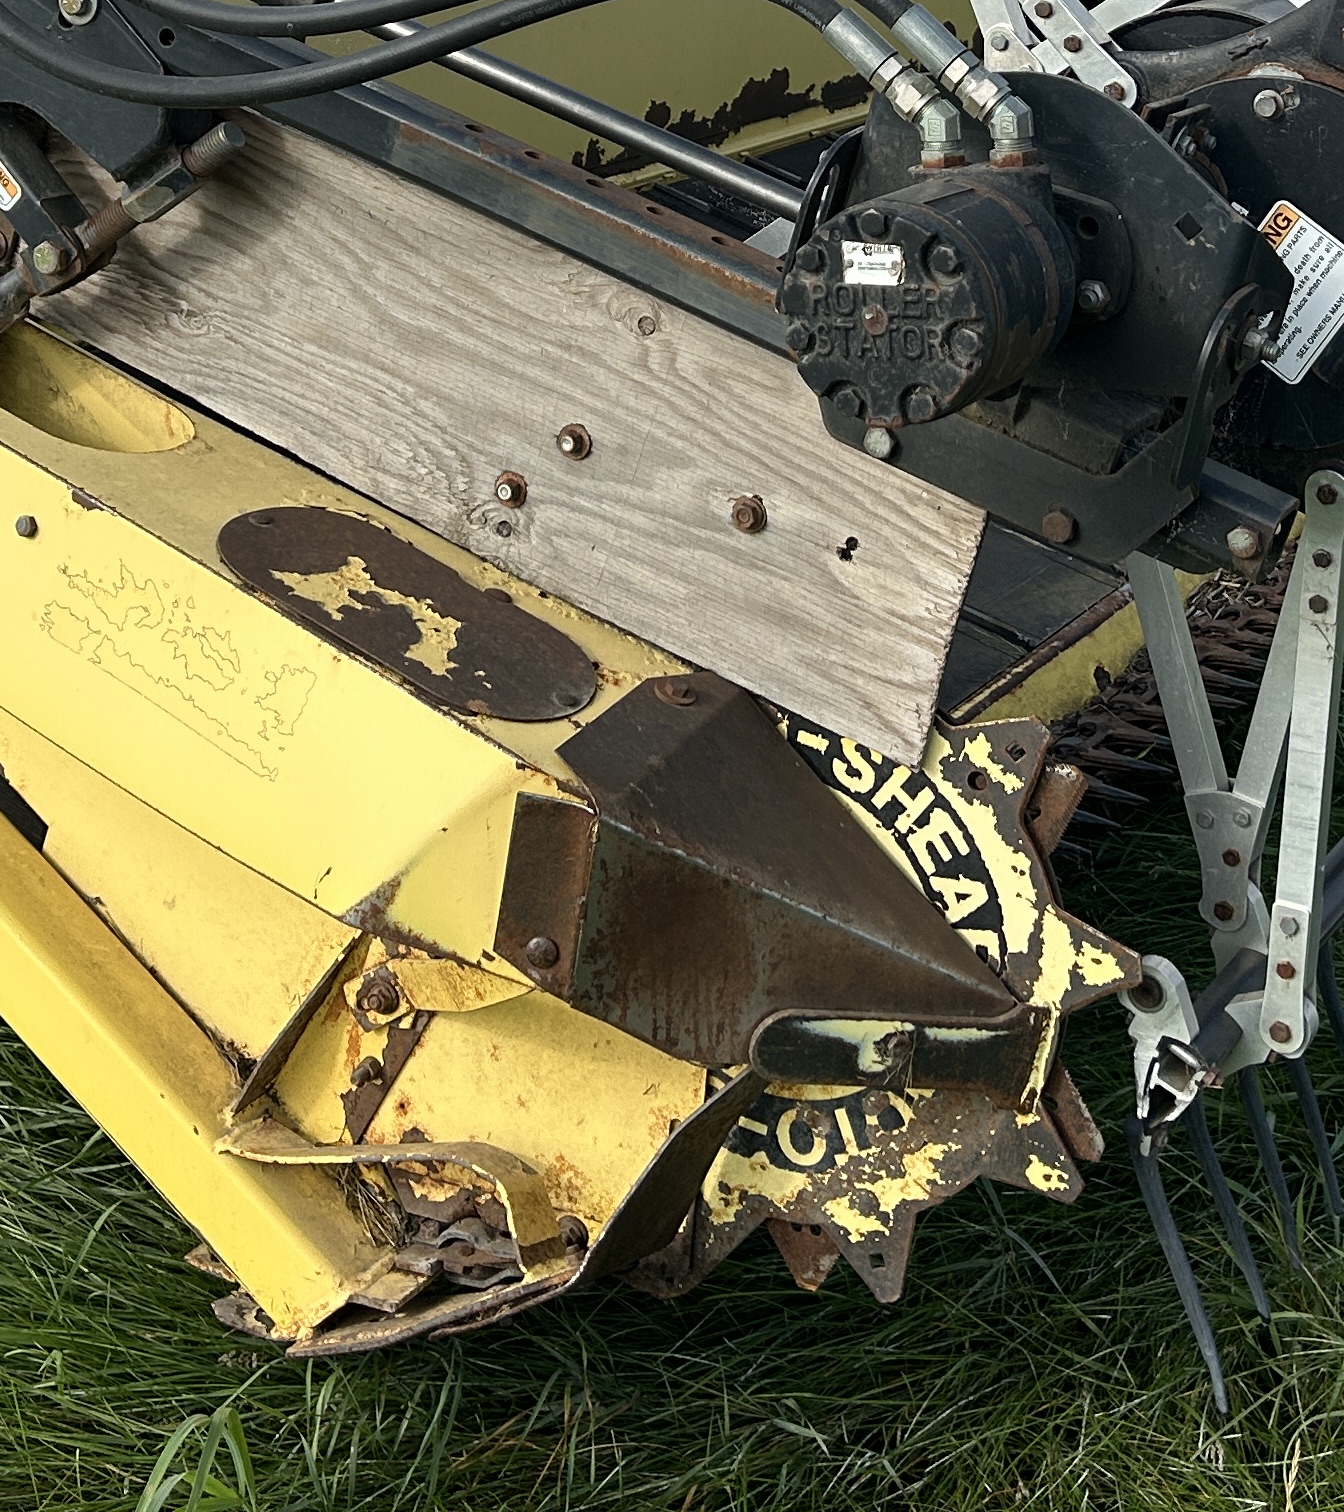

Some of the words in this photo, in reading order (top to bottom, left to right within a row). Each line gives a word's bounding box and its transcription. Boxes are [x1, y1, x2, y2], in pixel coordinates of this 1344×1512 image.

[1286, 226, 1307, 250] PARTS
[1294, 252, 1311, 274] death
[1309, 235, 1324, 253] from
[1288, 315, 1294, 323] in
[1293, 297, 1308, 317] place
[1307, 278, 1322, 295] when
[1320, 250, 1343, 279] machine
[1293, 275, 1310, 295] make
[1310, 255, 1325, 273] sure
[1325, 241, 1334, 253] all
[810, 283, 944, 319] ROLLER
[813, 318, 944, 360] STATOR
[1296, 343, 1310, 359] SEE
[1307, 314, 1332, 345] OWNERS
